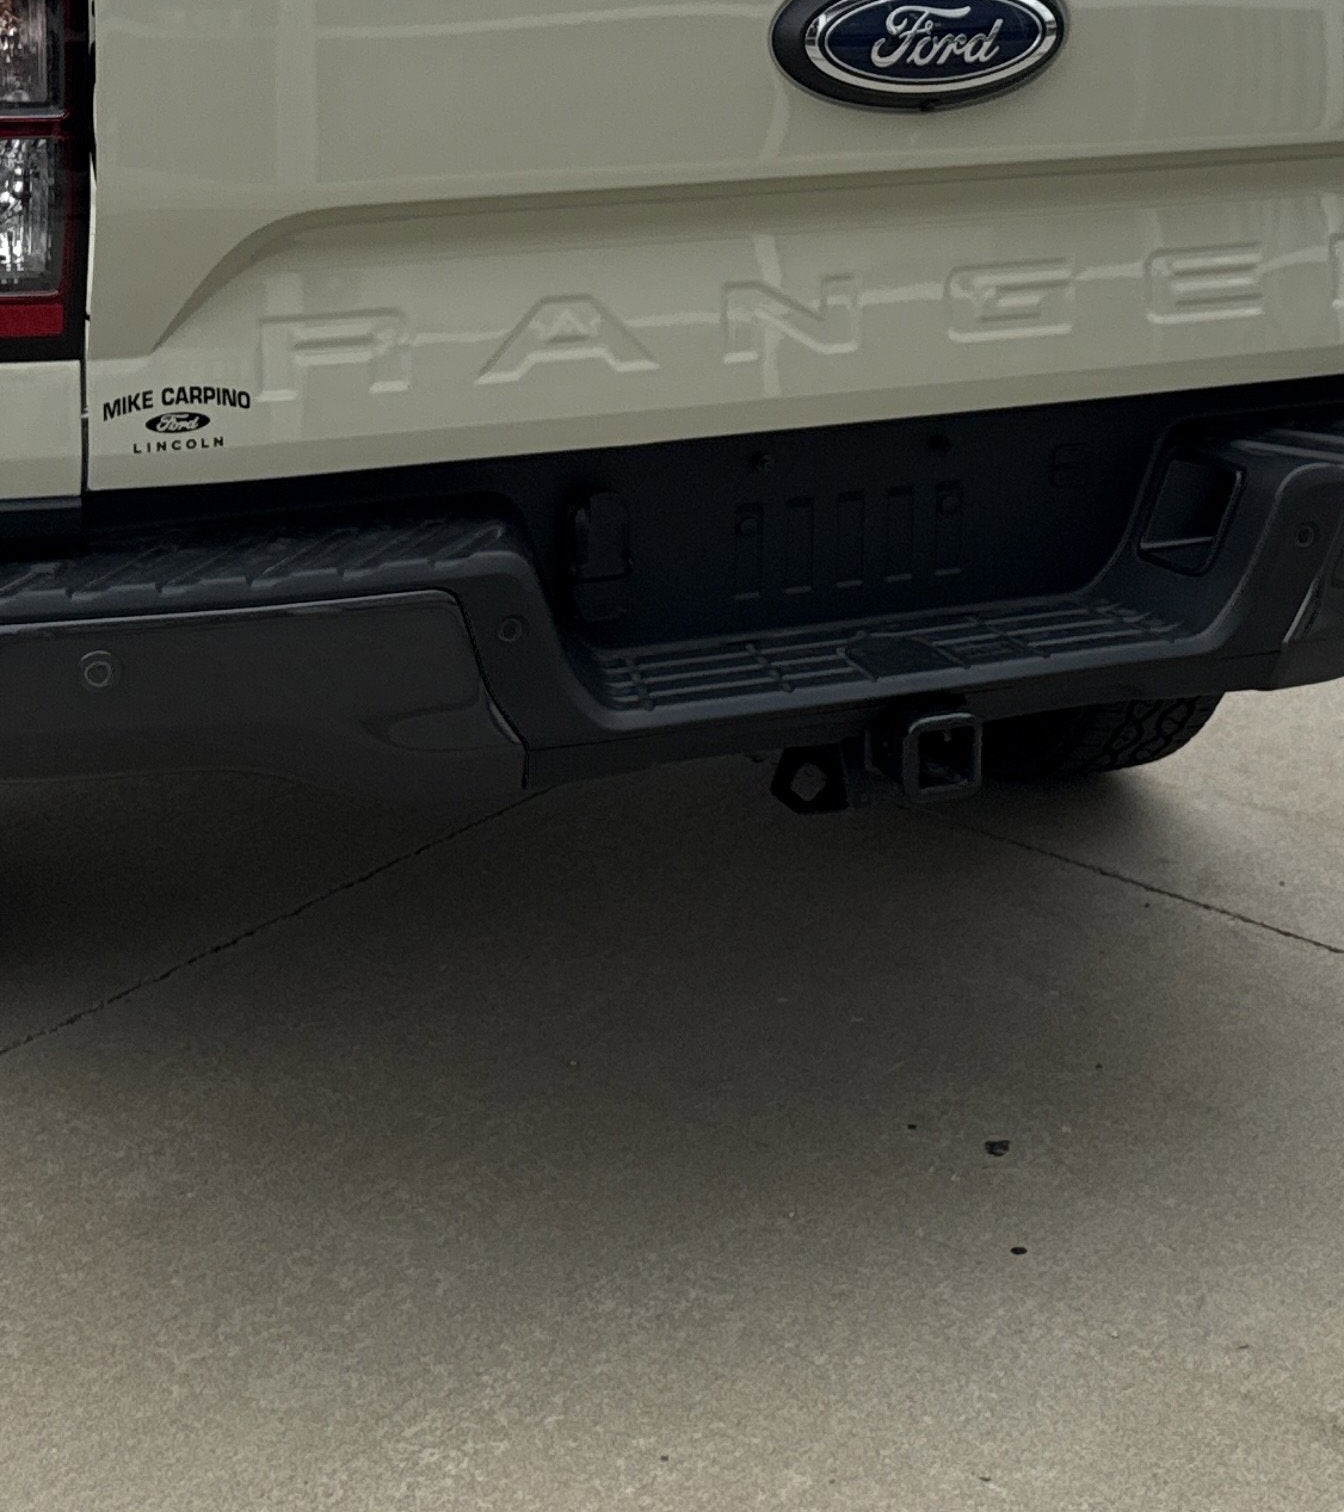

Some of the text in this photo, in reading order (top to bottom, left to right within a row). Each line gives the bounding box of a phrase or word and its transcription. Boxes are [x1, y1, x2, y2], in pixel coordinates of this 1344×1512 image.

[870, 4, 1005, 68] Ford
[103, 385, 251, 422] MIKE CARPINO
[157, 413, 201, 432] Ford
[133, 436, 224, 454] LINCOLN
